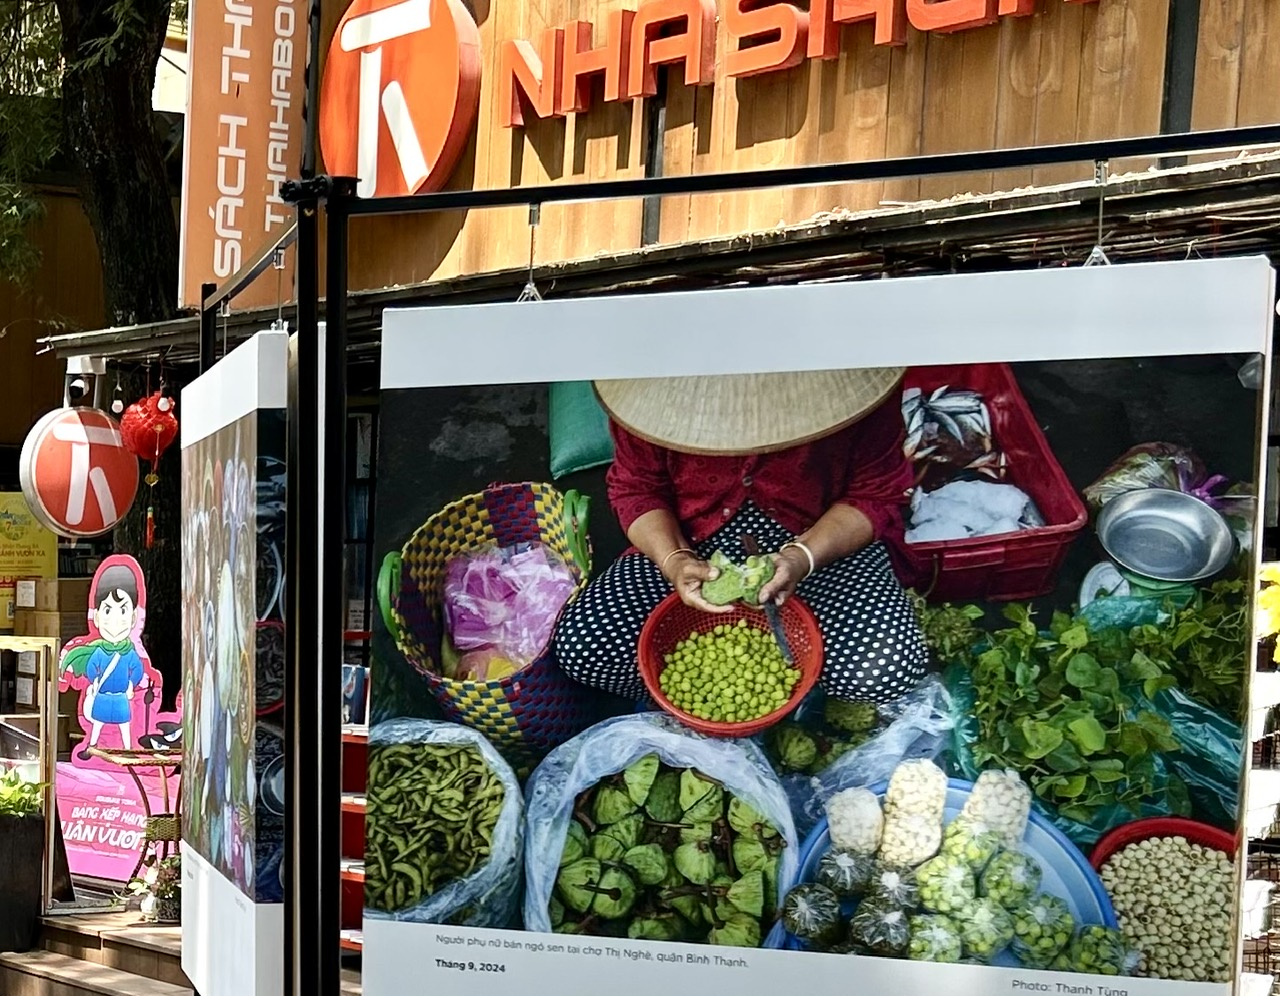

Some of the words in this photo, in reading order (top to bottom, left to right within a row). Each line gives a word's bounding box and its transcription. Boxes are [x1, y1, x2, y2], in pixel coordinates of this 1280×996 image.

[265, 0, 297, 232] THAIHABO
[208, 114, 248, 278] SÁCH
[60, 819, 99, 842] UÂN
[435, 933, 466, 947] Người
[467, 936, 486, 950] phụ
[503, 938, 523, 950] bán
[547, 944, 565, 953] sen
[435, 958, 466, 972] Tháng
[468, 961, 478, 972] 9,
[479, 962, 506, 973] 2024
[1011, 979, 1052, 992] Photo:
[1055, 983, 1093, 995] Thanh
